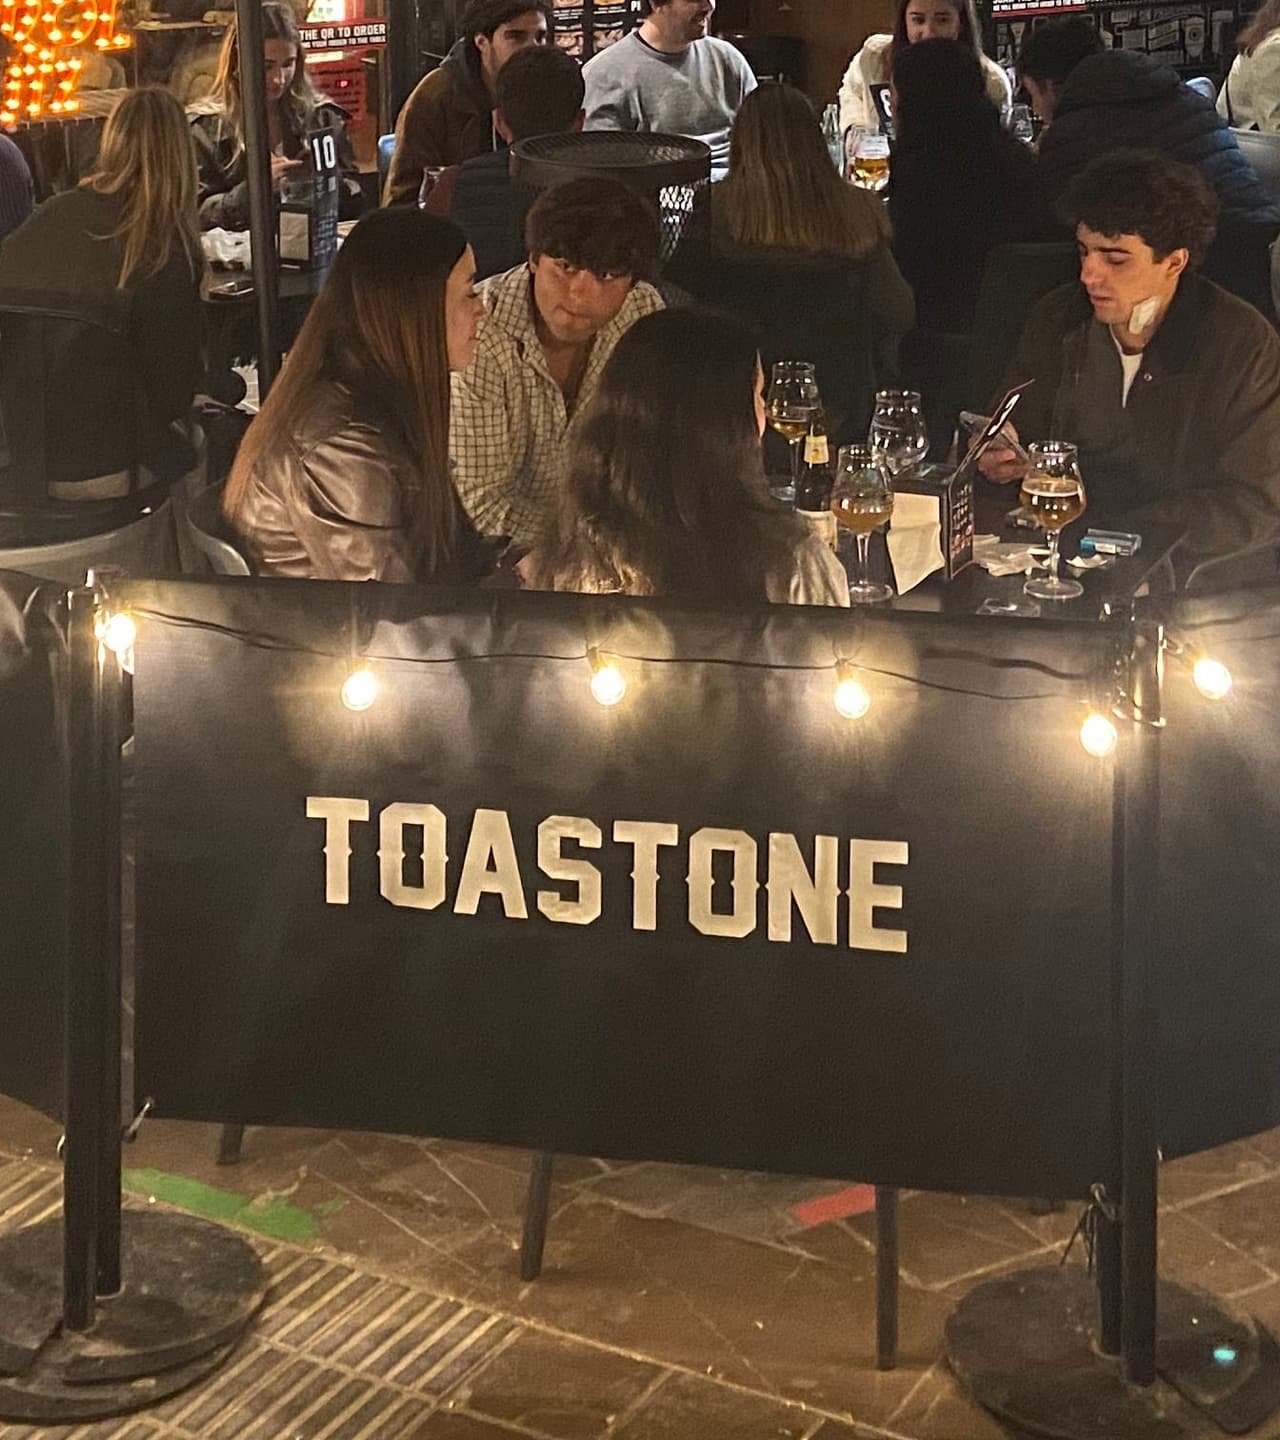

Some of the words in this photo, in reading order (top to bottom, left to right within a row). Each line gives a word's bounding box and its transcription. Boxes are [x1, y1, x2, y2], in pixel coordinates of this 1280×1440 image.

[300, 29, 319, 41] THE
[320, 28, 334, 39] QR
[336, 27, 351, 37] TO
[353, 24, 386, 36] ORDER
[313, 135, 336, 171] 10
[306, 796, 909, 953] TOASTONE
